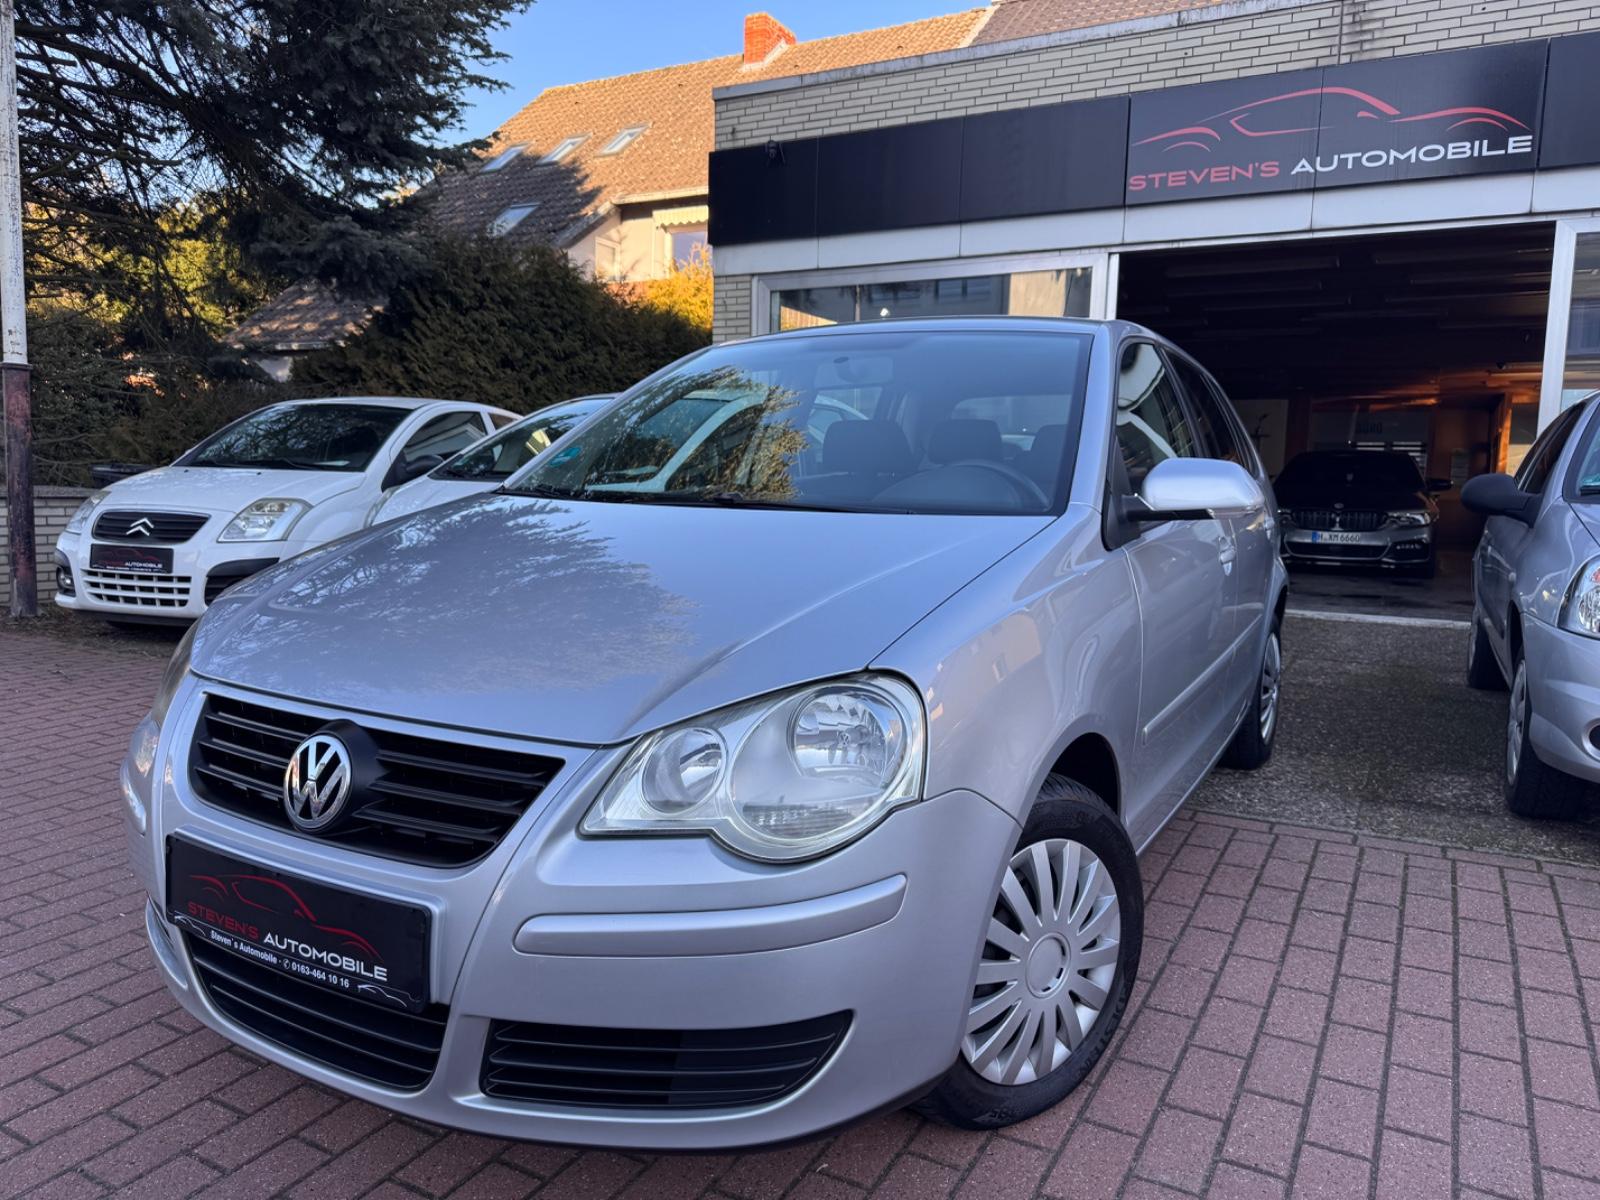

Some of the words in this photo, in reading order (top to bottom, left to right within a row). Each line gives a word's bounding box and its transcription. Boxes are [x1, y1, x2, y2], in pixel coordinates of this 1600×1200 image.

[1128, 161, 1280, 192] STEVEN'S
[1291, 135, 1533, 176] AUTOMOBILE
[188, 902, 260, 939] STEVEN'S
[263, 932, 388, 982] AUTOMOBILE
[240, 942, 278, 964] Automobile
[291, 961, 326, 981] 0163-464
[328, 974, 338, 984] 10
[340, 978, 350, 988] 16
